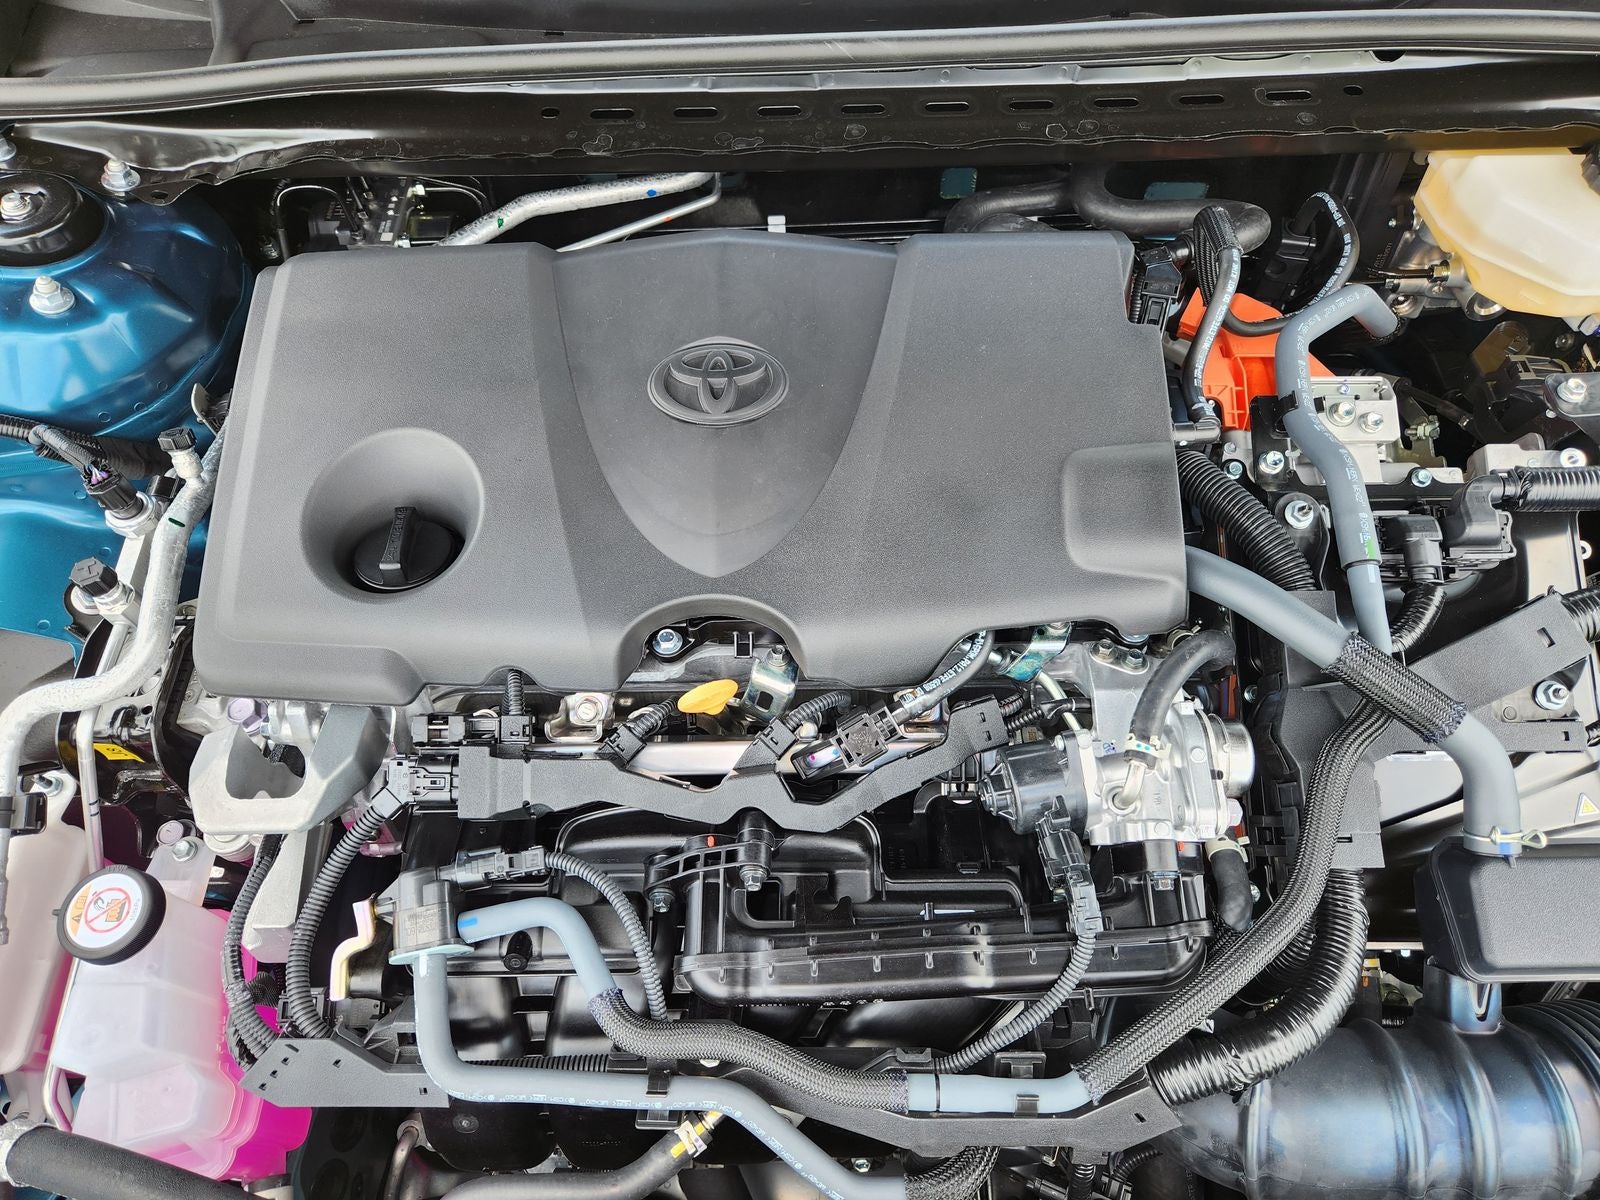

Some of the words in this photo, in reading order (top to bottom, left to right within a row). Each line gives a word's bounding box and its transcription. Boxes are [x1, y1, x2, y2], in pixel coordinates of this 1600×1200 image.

[1226, 280, 1236, 293] NOT
[1222, 293, 1231, 303] DO
[216, 1016, 227, 1054] FULL
